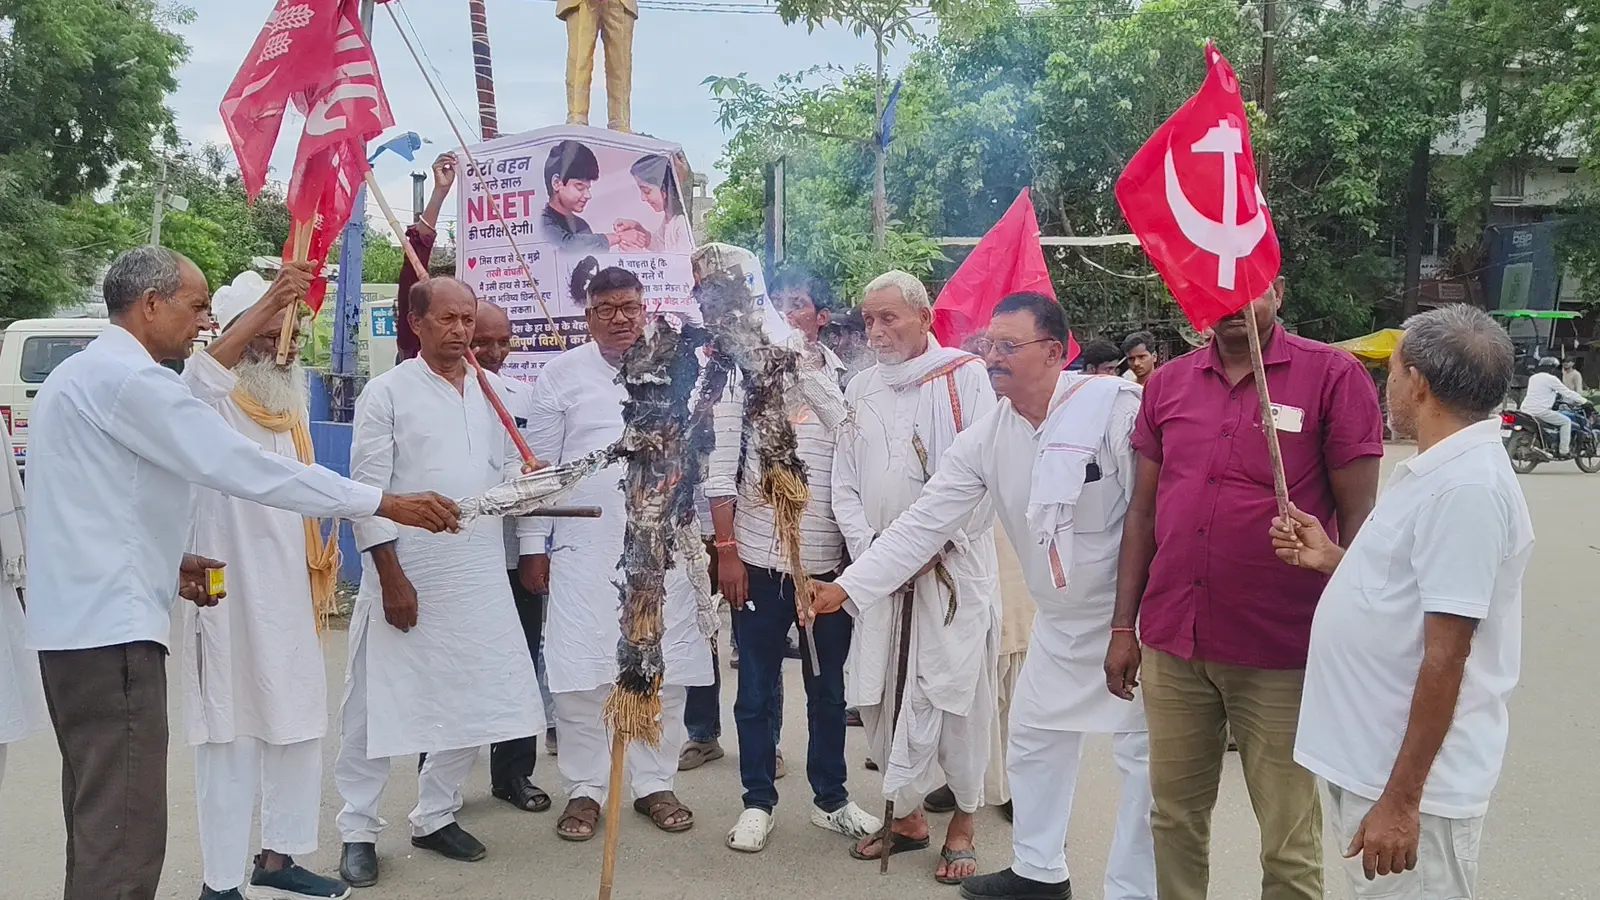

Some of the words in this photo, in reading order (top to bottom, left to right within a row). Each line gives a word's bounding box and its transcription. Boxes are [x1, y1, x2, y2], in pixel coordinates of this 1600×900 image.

[497, 156, 532, 174] बहन
[500, 177, 522, 189] साल
[467, 189, 535, 224] NEET
[468, 226, 478, 240] की
[479, 255, 492, 266] जिस
[493, 254, 507, 265] हाथ
[508, 252, 514, 263] से
[527, 250, 541, 263] मुझे
[657, 258, 667, 267] कि
[641, 270, 654, 280] गले
[485, 280, 497, 291] उसी
[498, 281, 512, 291] हाथ
[513, 278, 520, 289] से
[540, 291, 552, 303] हुए
[511, 323, 523, 333] देश
[524, 322, 533, 332] के
[534, 323, 543, 332] हर
[561, 320, 570, 331] के
[570, 333, 587, 344] कर
